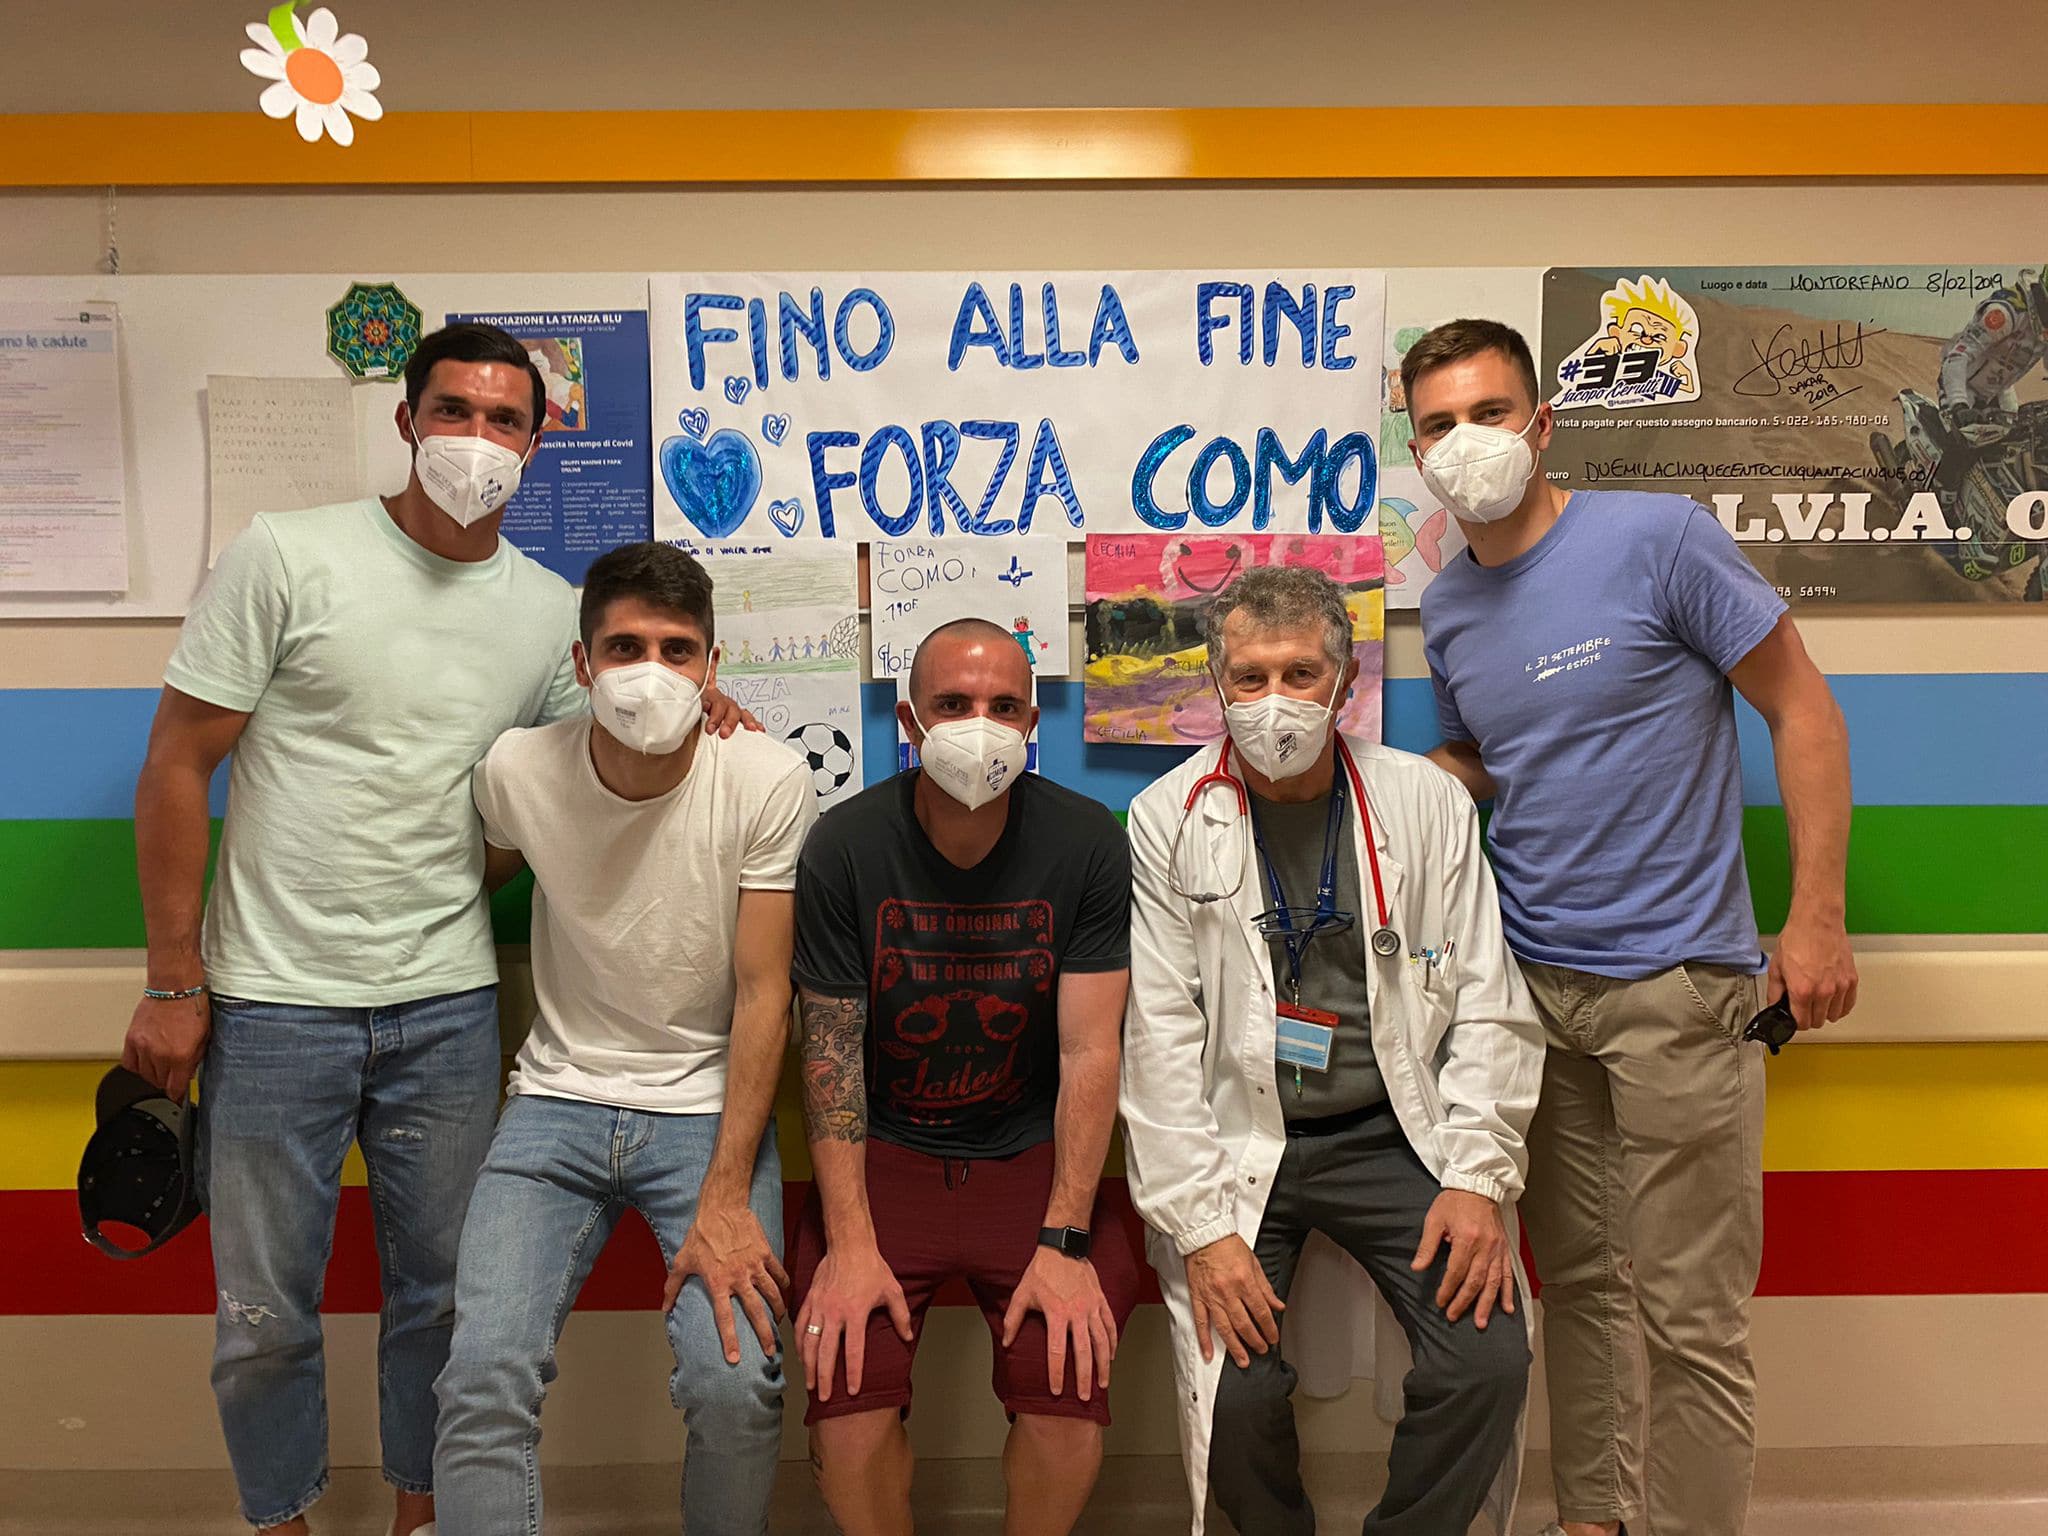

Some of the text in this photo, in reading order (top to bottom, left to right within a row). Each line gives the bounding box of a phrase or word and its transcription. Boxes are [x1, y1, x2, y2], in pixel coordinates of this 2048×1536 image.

[1700, 280, 1768, 292] Luogo e data
[1926, 269, 2003, 298] 8/02/2019
[546, 315, 560, 325] LA
[562, 314, 600, 324] STANZA
[602, 314, 622, 324] BLU
[42, 336, 88, 348] cadute
[684, 282, 1357, 391] FINO ALLA FINE
[1788, 374, 1829, 396] DAKAR
[1804, 384, 1838, 404] 2019
[1552, 388, 1606, 408] Jacopo
[1556, 418, 1580, 428] vista
[1582, 418, 1615, 430] pagate
[1616, 420, 1633, 430] per
[1636, 418, 1669, 430] questo
[1671, 418, 1713, 430] assegno
[1716, 416, 1759, 427] bancario
[1760, 418, 1770, 426] n.
[540, 440, 634, 450] nascita in tempo di Covid
[807, 418, 1378, 538] FORZA COMO
[1546, 471, 1570, 480] euro
[1773, 586, 1836, 596] 98 58994
[1536, 656, 1548, 668] 31
[1551, 637, 1612, 662] SETTEMBRE
[1566, 652, 1601, 671] ESISTE
[715, 678, 792, 706] ORZA
[913, 914, 1020, 932] THE ORIGINAL
[912, 962, 1022, 981] THE ORIGINAL
